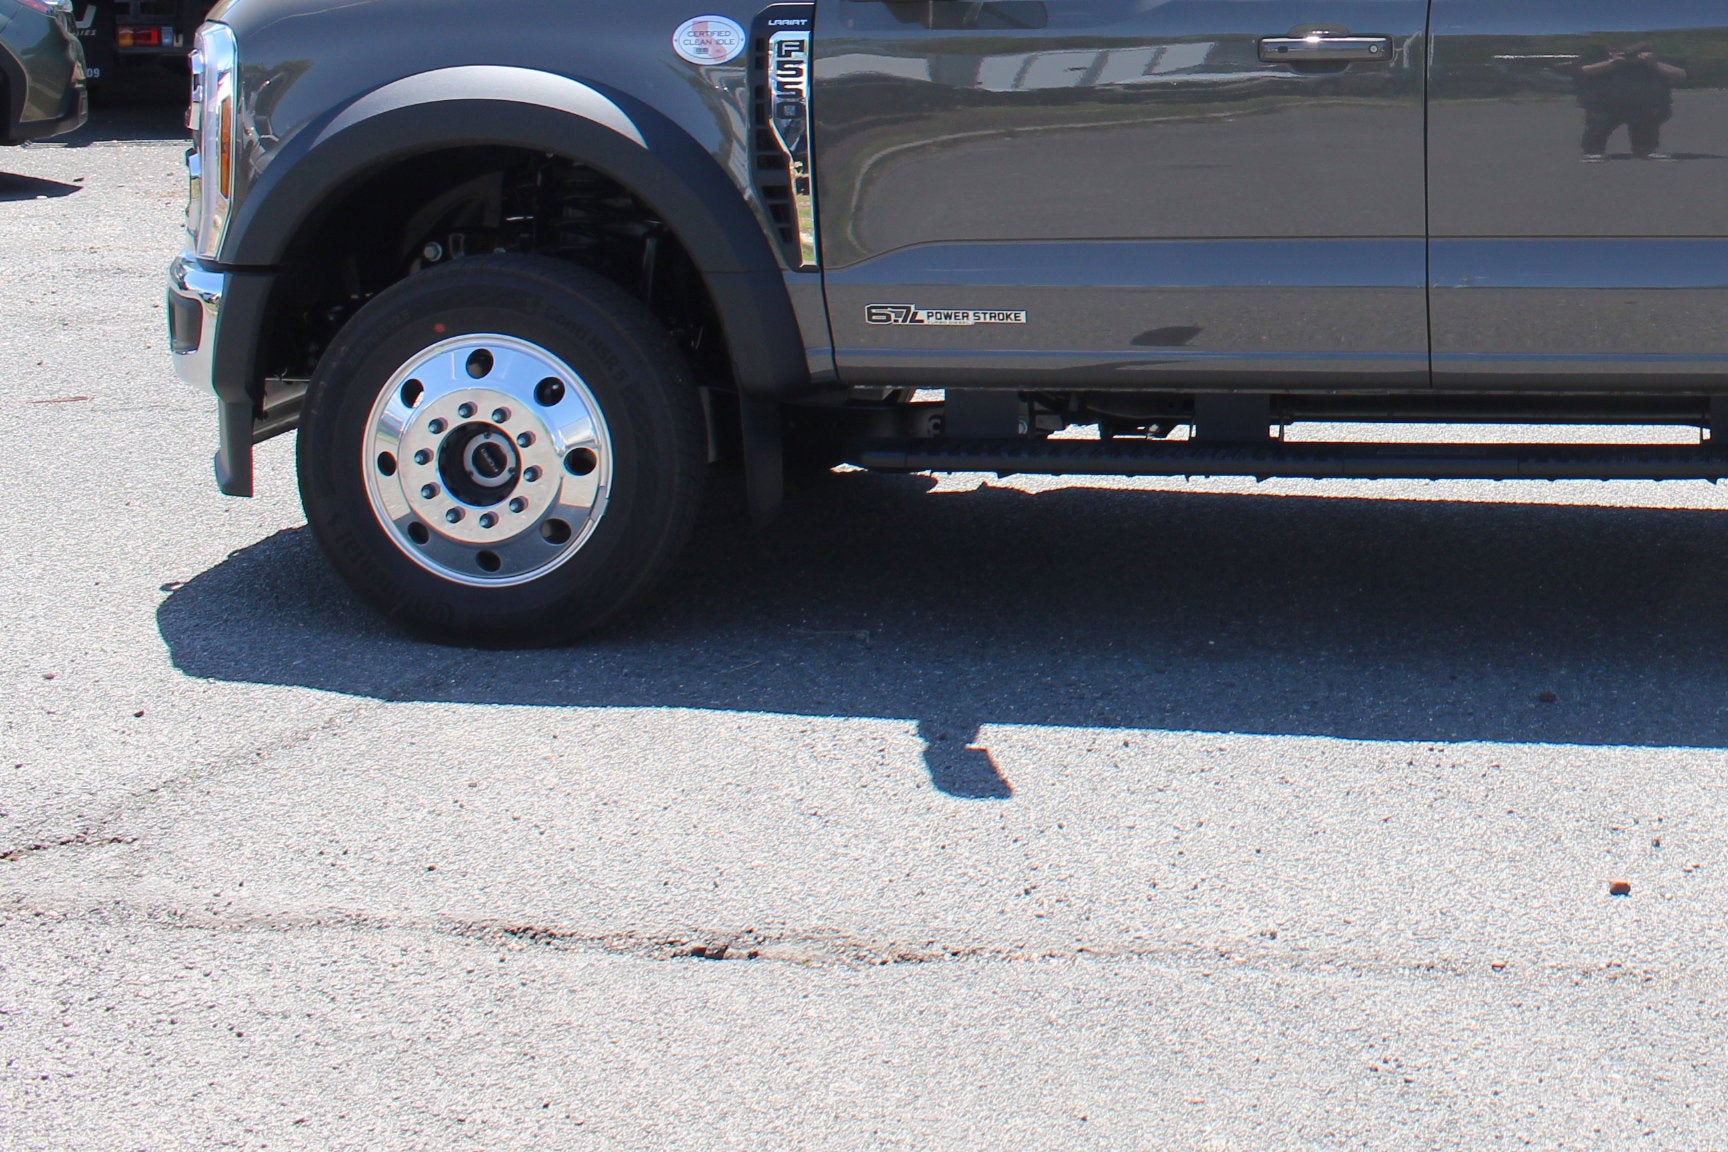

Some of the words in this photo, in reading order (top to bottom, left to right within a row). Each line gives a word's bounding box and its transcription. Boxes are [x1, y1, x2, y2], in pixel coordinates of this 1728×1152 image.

[767, 19, 808, 27] LARIAT
[687, 30, 732, 38] CERTIFIED
[682, 38, 714, 46] CLEAN
[866, 305, 924, 324] 6.7L
[926, 311, 970, 321] POWER
[973, 311, 1022, 322] STROKE
